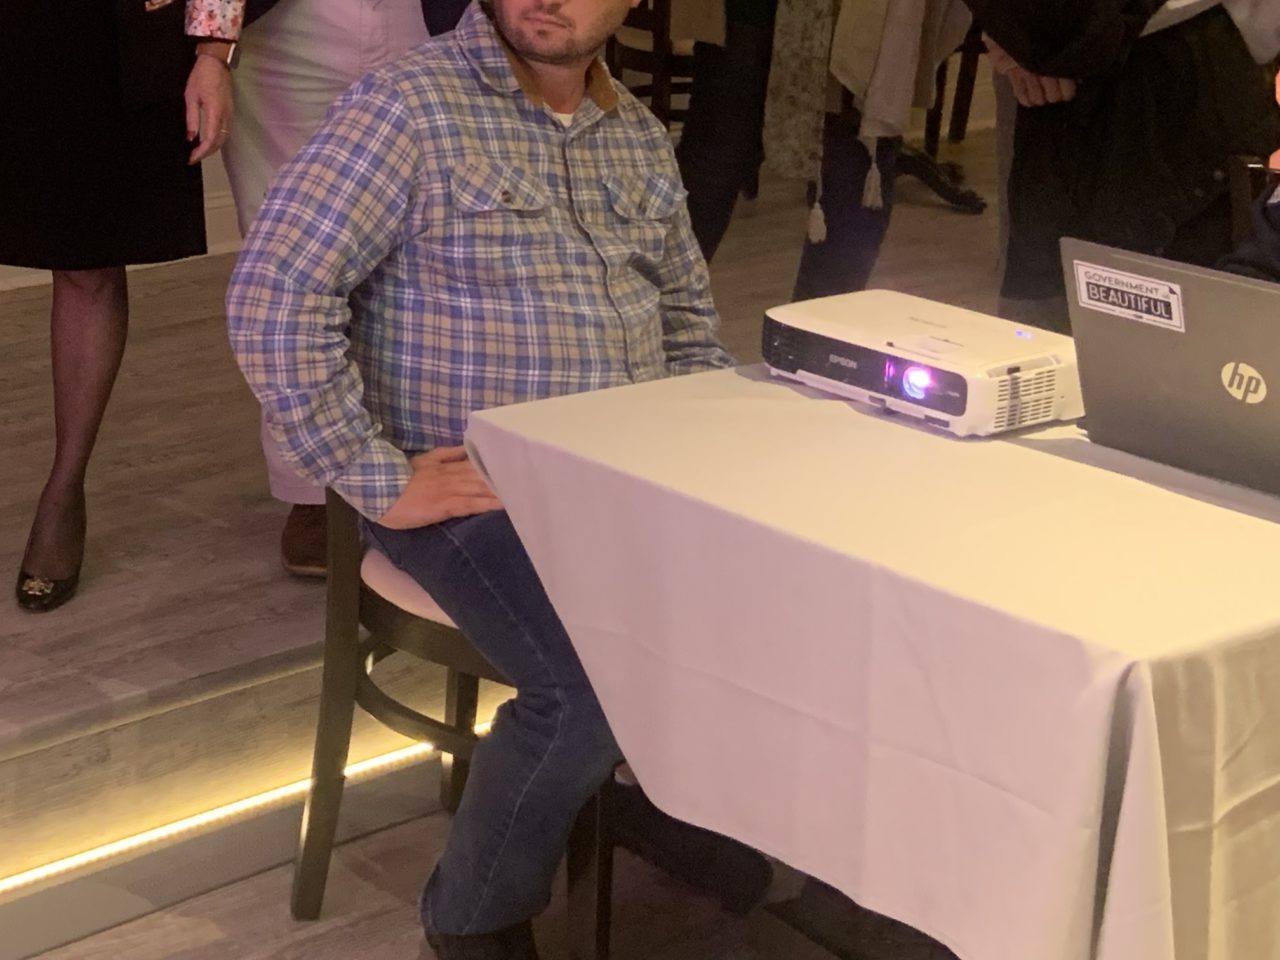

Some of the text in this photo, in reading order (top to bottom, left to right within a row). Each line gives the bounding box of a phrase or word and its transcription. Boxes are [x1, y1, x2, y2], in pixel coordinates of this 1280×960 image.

[1084, 270, 1160, 295] GOVERNMENT
[1088, 283, 1171, 319] BEAUTIFUL
[829, 352, 858, 369] EPSON
[1227, 362, 1262, 402] hp
